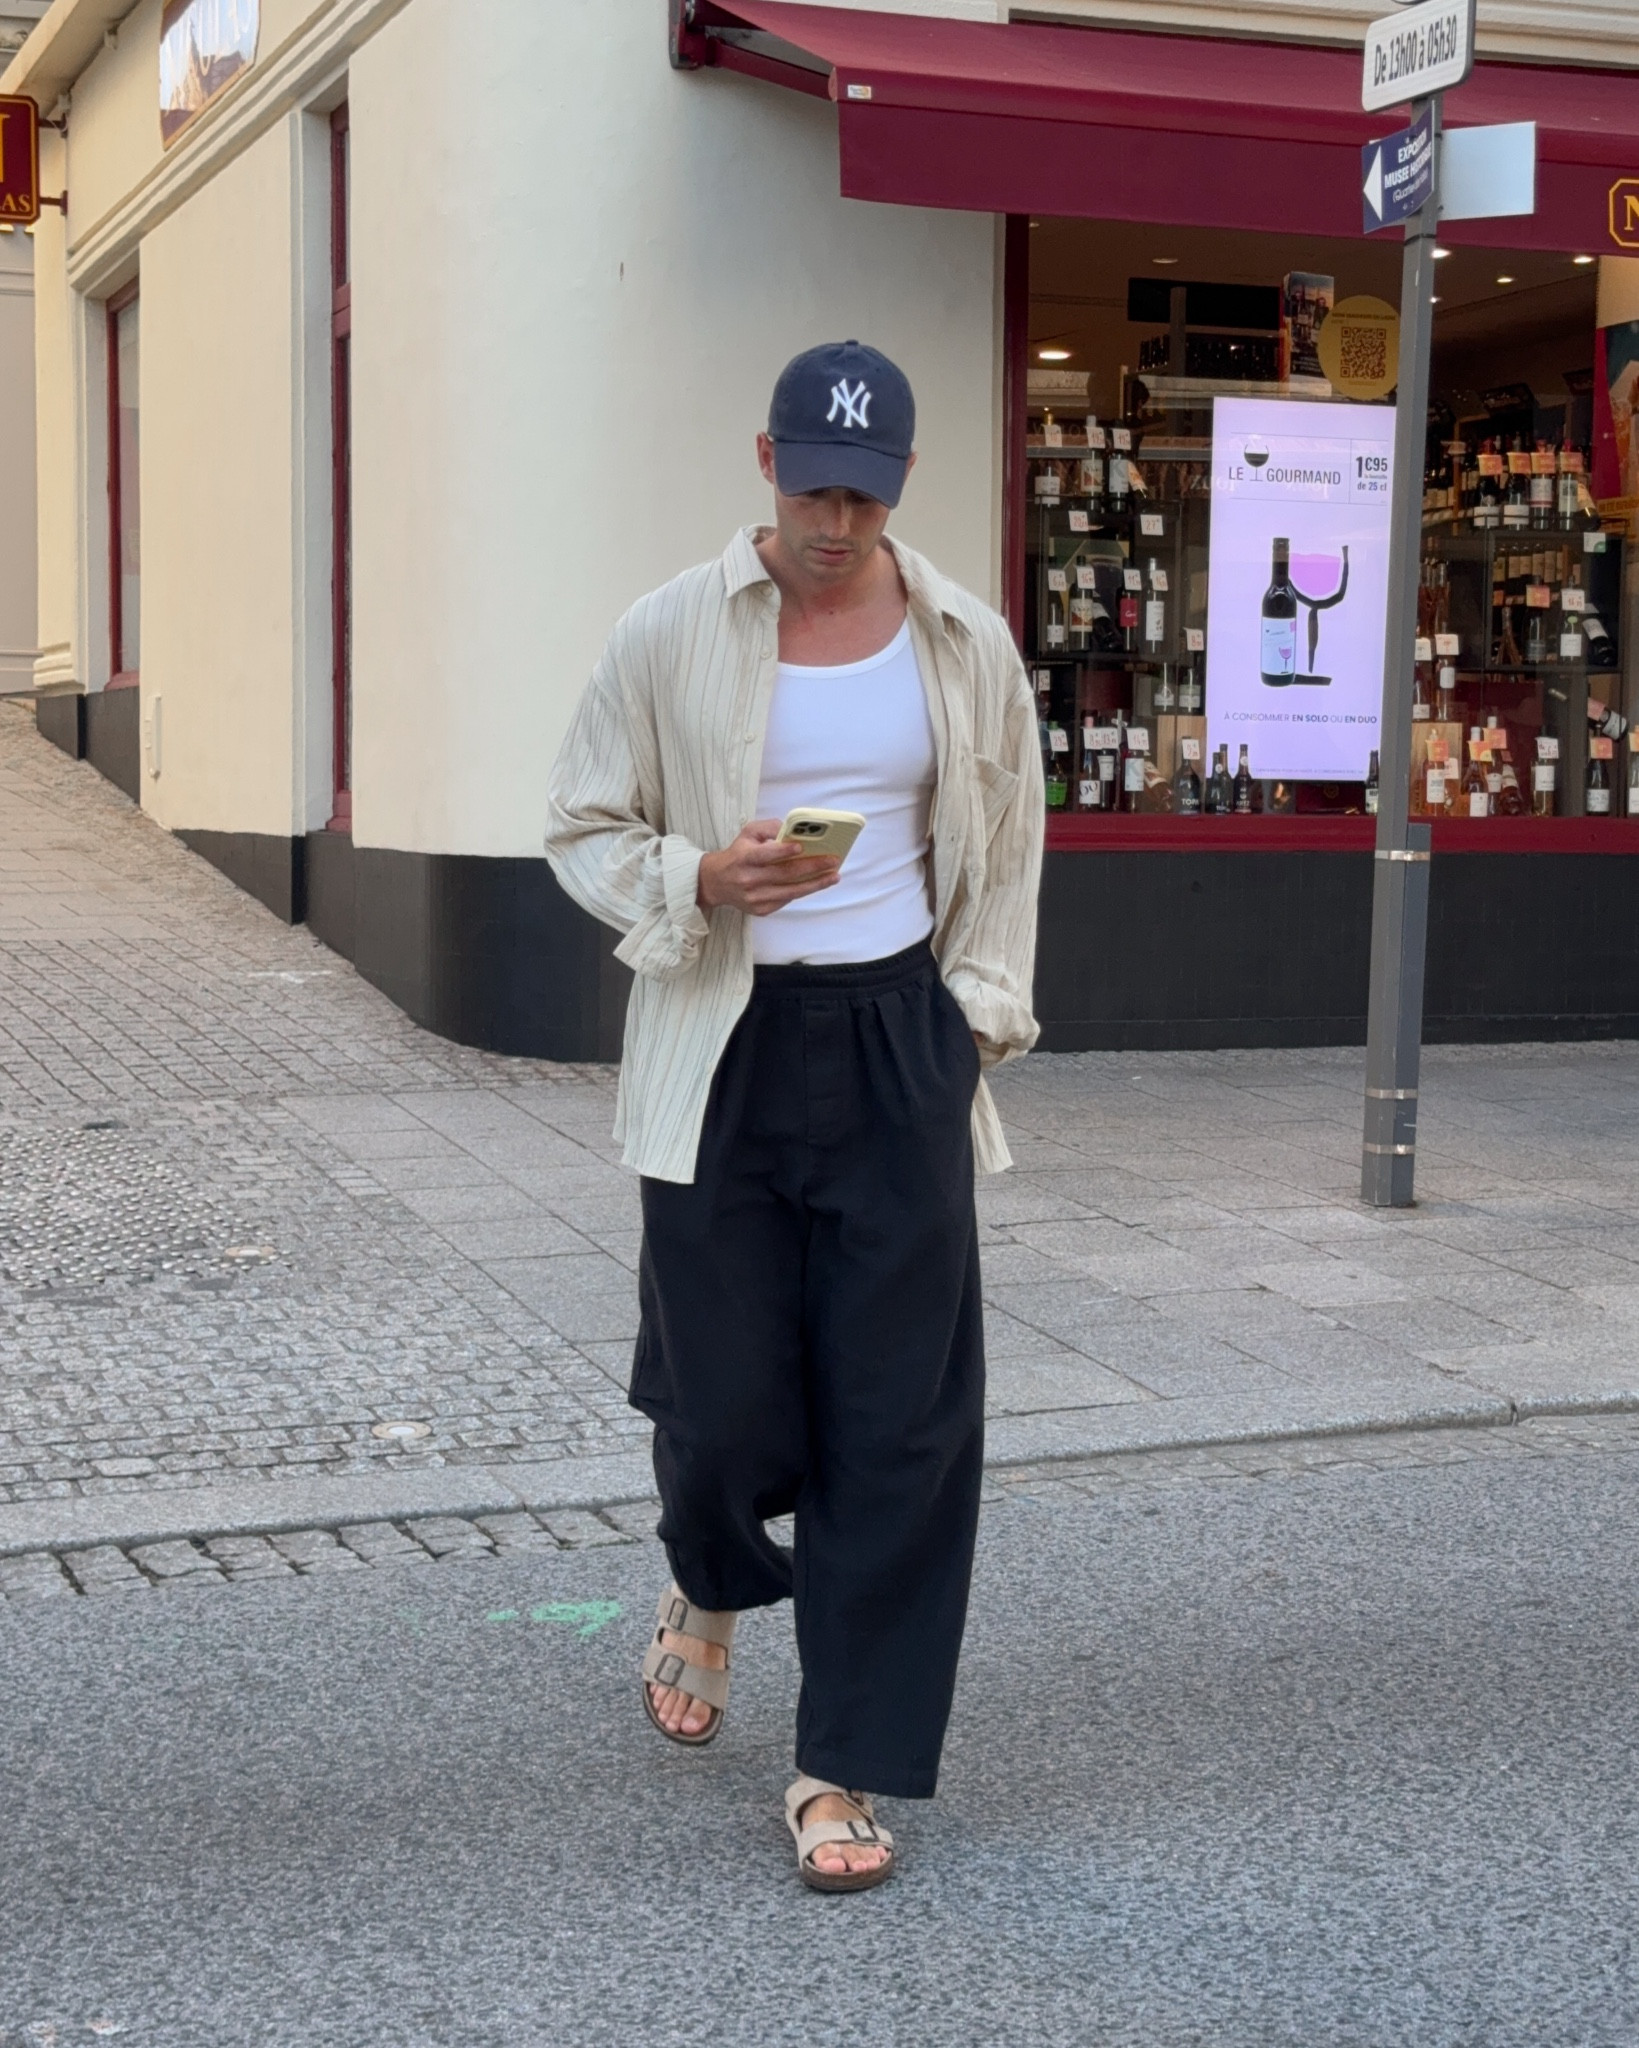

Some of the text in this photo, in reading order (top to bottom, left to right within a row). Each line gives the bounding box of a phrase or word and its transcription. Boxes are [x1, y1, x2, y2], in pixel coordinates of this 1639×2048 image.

[1374, 14, 1457, 87] De 13h00 à 05h30
[826, 378, 872, 429] NY
[1229, 466, 1341, 485] LE GOURMAND
[1357, 481, 1366, 491] de
[1368, 482, 1378, 491] 25
[1232, 712, 1290, 722] CONSOMMER
[1292, 714, 1303, 722] EN
[1305, 714, 1329, 723] SOLO
[1330, 715, 1343, 723] OU
[1345, 715, 1356, 723] EN
[1358, 716, 1377, 724] DUO
